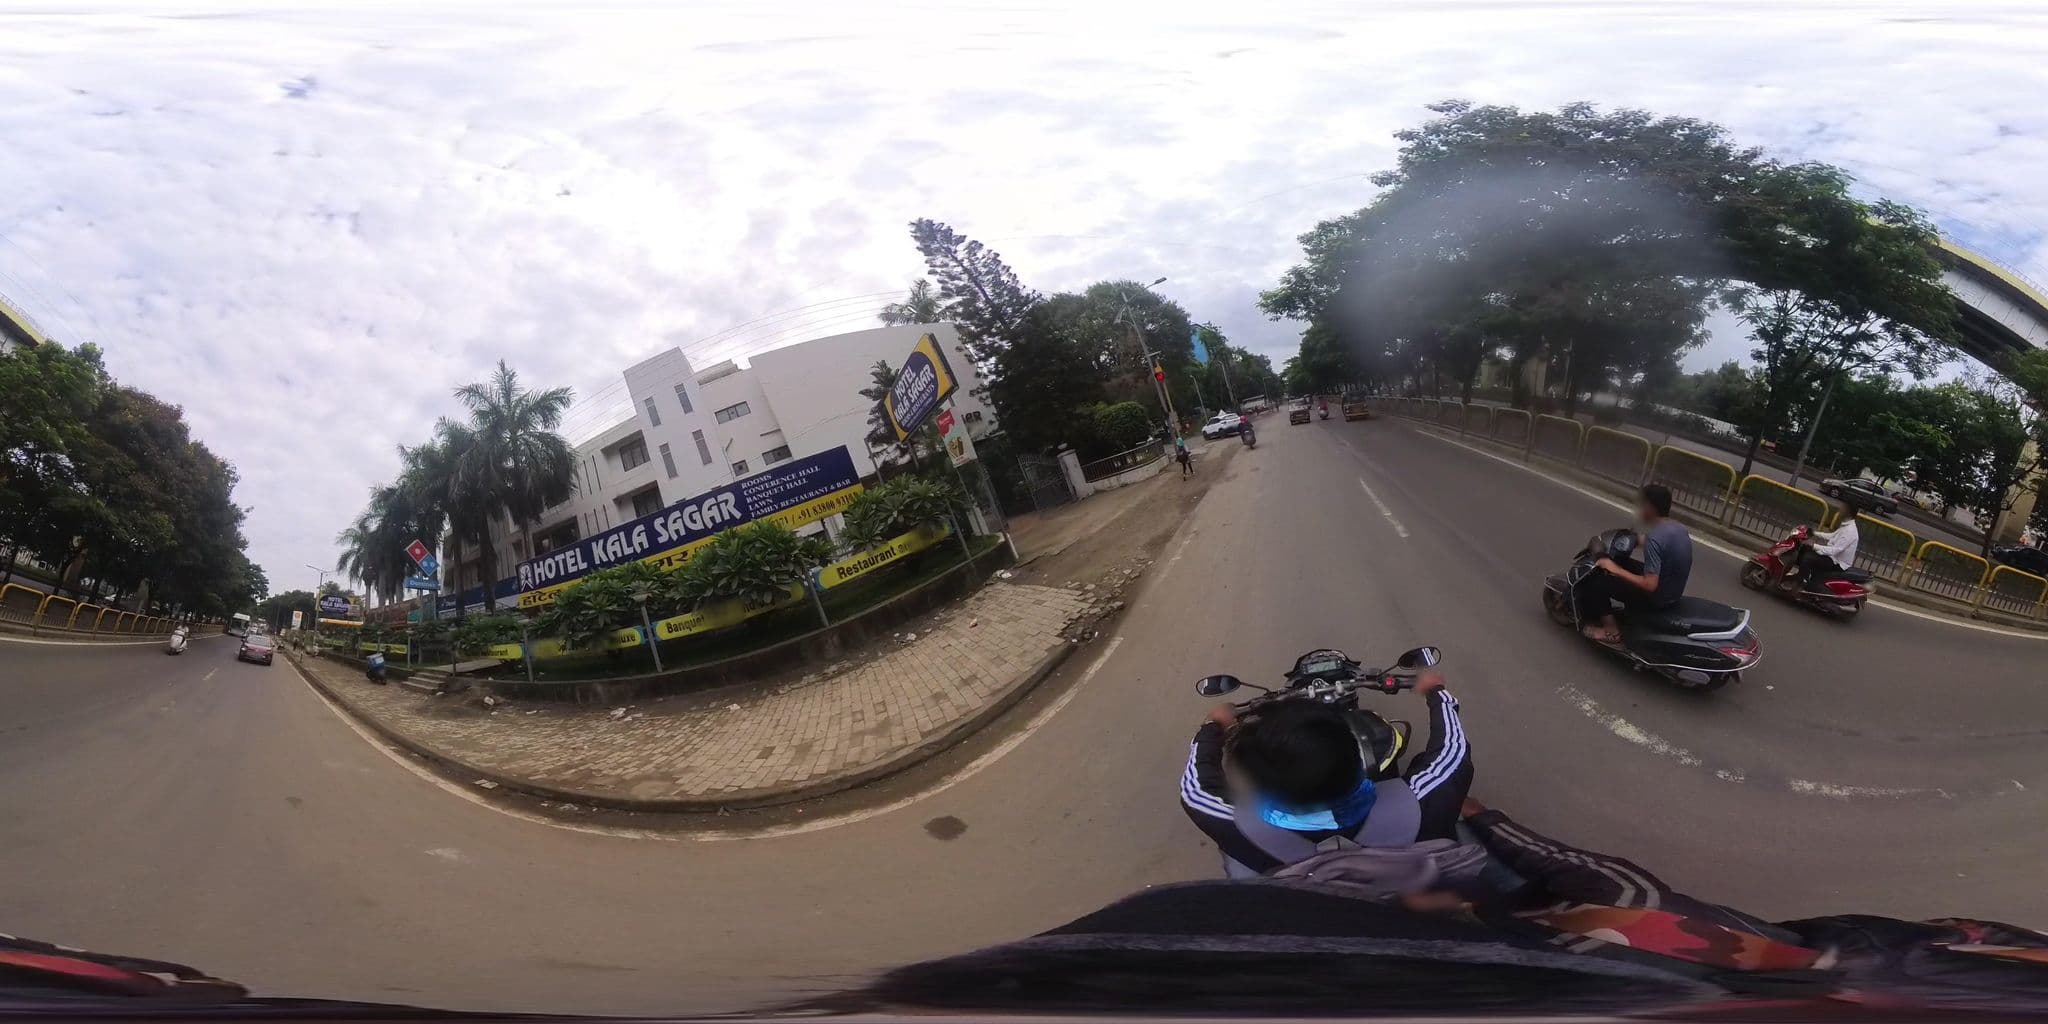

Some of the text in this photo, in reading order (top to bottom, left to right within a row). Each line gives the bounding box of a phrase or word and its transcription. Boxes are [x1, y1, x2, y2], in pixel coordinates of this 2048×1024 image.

[894, 396, 911, 422] KALA
[908, 364, 935, 402] SAGAR
[895, 366, 916, 398] HOTEL
[741, 474, 772, 489] ROOMS
[743, 465, 821, 496] CONFERENCE HALL
[746, 479, 809, 504] BANQUET HALL
[749, 498, 774, 511] LAWN
[751, 503, 779, 518] FAMILY
[780, 486, 829, 506] RESTAURANT
[836, 479, 852, 489] BAR
[533, 491, 743, 586] HOTEL KALA SAGAR
[836, 547, 897, 579] Restaurant
